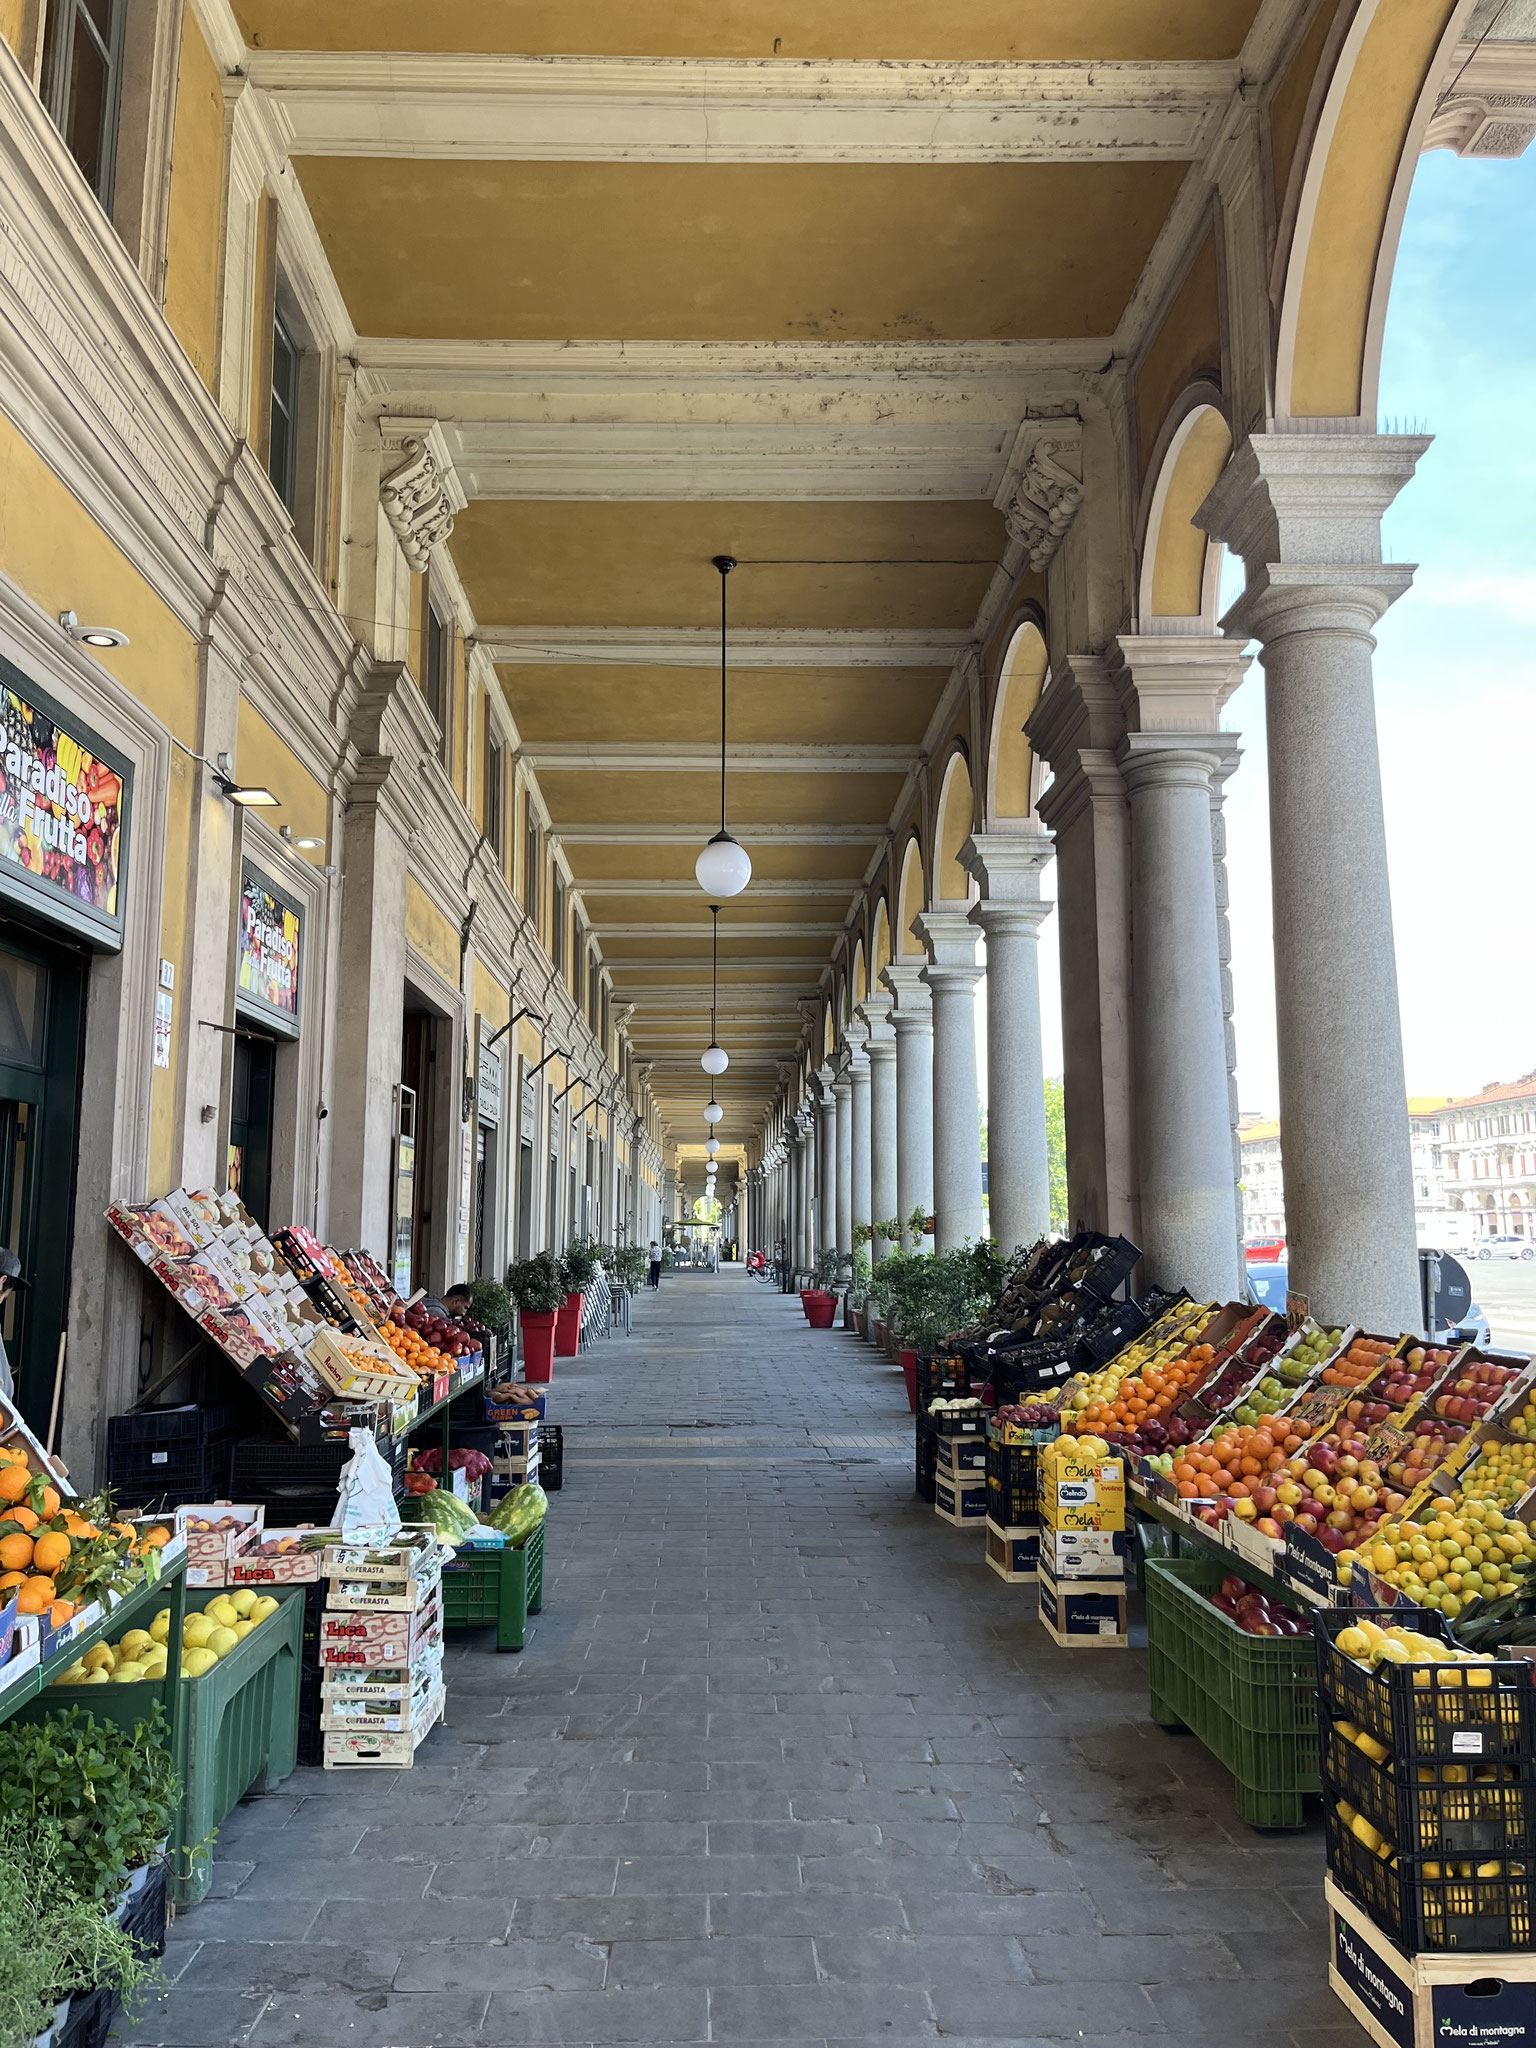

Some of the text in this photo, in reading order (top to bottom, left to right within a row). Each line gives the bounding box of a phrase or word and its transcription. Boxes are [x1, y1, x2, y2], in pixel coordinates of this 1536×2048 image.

[18, 785, 88, 866] Frutta
[247, 906, 292, 961] Paradiso
[260, 945, 292, 989] Frutta
[108, 1208, 133, 1239] Lica
[182, 1206, 201, 1231] DEL SOL
[154, 1260, 179, 1292] Lica
[223, 1256, 243, 1281] DEL SOL
[202, 1314, 228, 1344] Lica
[262, 1310, 282, 1335] DEL SOL
[301, 1363, 323, 1386] DEL SOL
[488, 1408, 518, 1416] GREEN
[233, 1566, 275, 1581] Lica
[345, 1566, 384, 1574] COFERASTA
[1304, 1555, 1333, 1579] montagna
[349, 1597, 390, 1605] COFERASTA
[327, 1621, 367, 1637] Lica
[326, 1648, 366, 1663] Lica
[1339, 1932, 1357, 1966] Mela
[1357, 1952, 1365, 1974] di
[1364, 1968, 1404, 2016] montagna
[1440, 2025, 1525, 2037] Mela di montagna
